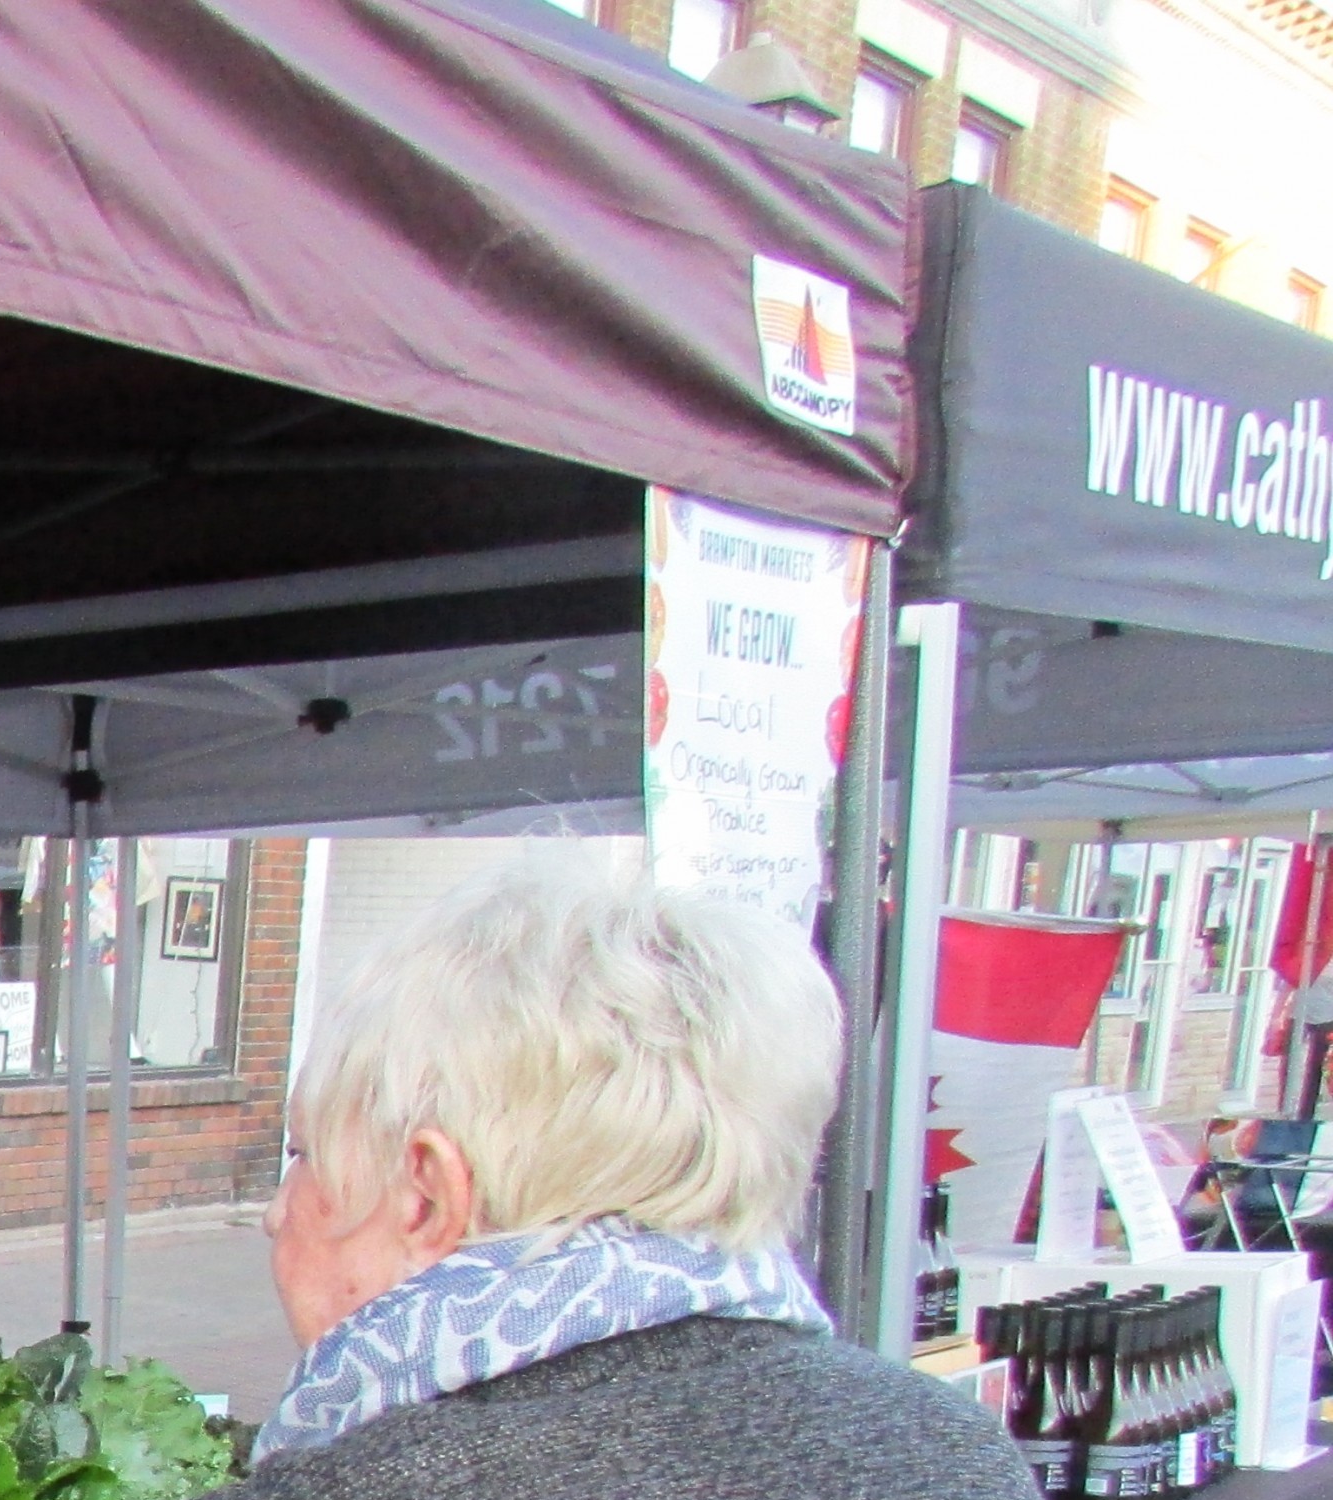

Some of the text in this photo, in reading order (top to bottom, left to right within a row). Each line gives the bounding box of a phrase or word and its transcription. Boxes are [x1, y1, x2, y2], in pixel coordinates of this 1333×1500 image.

[699, 528, 815, 583] BRAMPTON MARKETS
[706, 599, 732, 659] WE
[696, 671, 774, 742] Local
